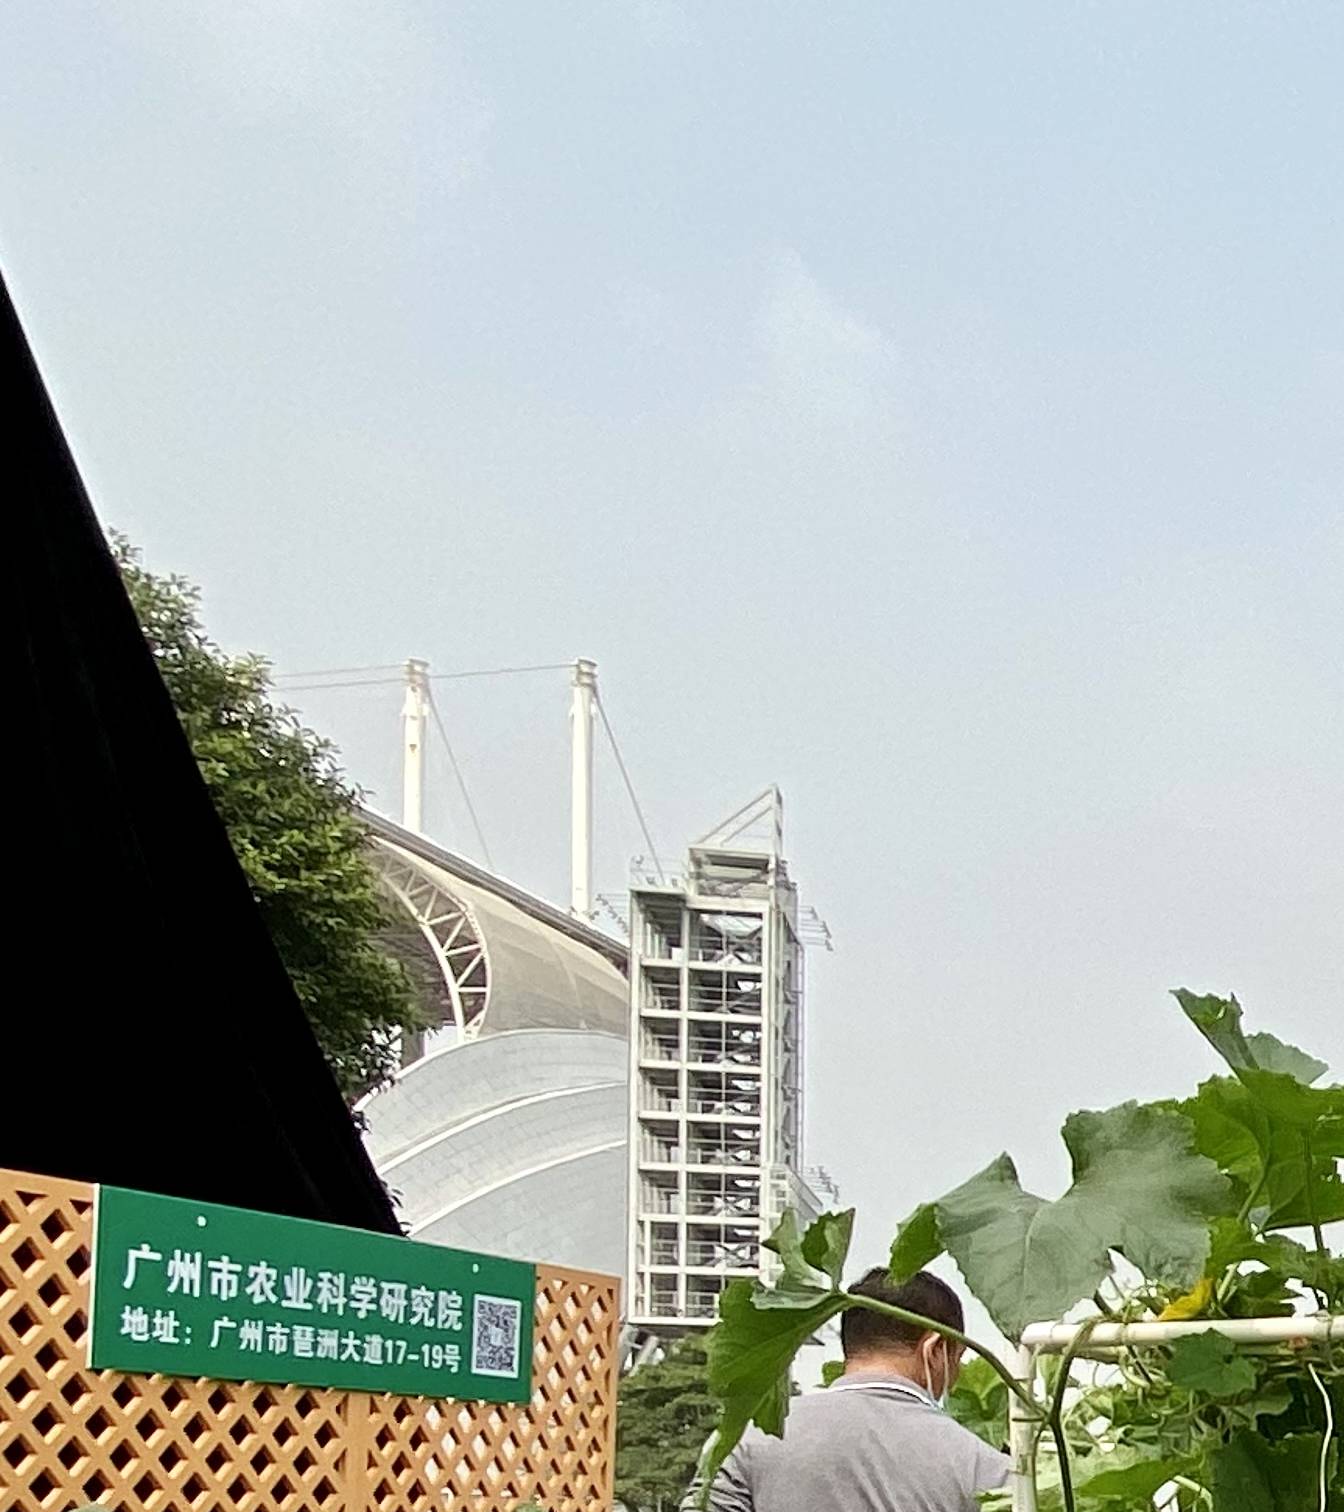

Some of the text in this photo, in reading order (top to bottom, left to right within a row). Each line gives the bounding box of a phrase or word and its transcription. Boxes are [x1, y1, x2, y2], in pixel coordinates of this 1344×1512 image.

[122, 1244, 463, 1331] 广州市农业科学研究院
